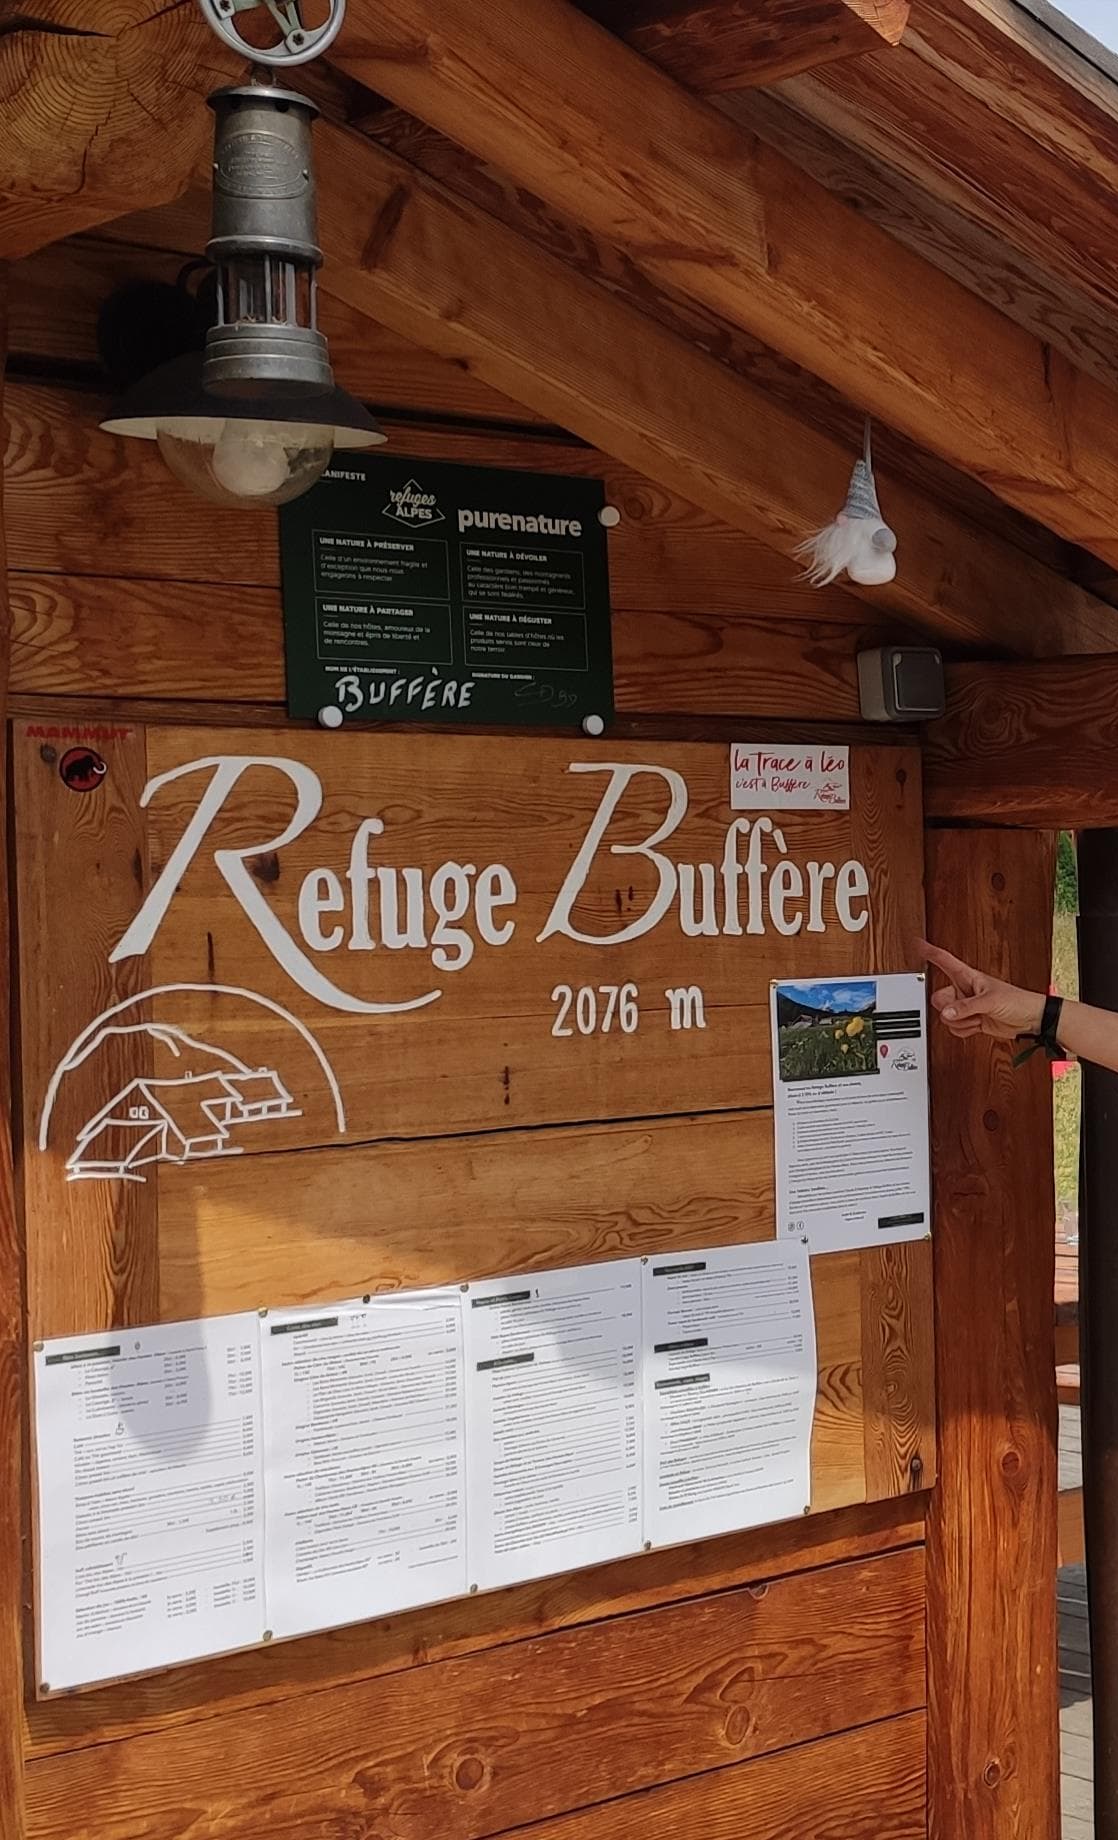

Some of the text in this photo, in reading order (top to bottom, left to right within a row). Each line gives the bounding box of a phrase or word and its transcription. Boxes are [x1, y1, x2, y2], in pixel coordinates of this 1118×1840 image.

[320, 469, 366, 481] ANIFESTE
[390, 486, 437, 506] refuges
[396, 504, 433, 520] ALPES
[457, 507, 582, 537] purenature
[320, 537, 335, 545] UNE
[336, 539, 365, 548] NATURE
[374, 541, 414, 551] PRÉSERVER
[481, 551, 507, 559] NATURE
[516, 552, 547, 561] DÉVOILER
[323, 604, 338, 612] UNE
[339, 605, 368, 614] NATURE
[377, 607, 414, 616] PARTAGER
[484, 614, 510, 622] NATURE
[519, 615, 552, 624] DÉGUSTER
[334, 667, 476, 712] BUFFÈRE
[26, 726, 133, 739] MAMMUT
[108, 755, 870, 1014] Refuge Buffère
[551, 983, 706, 1037] 2076 m
